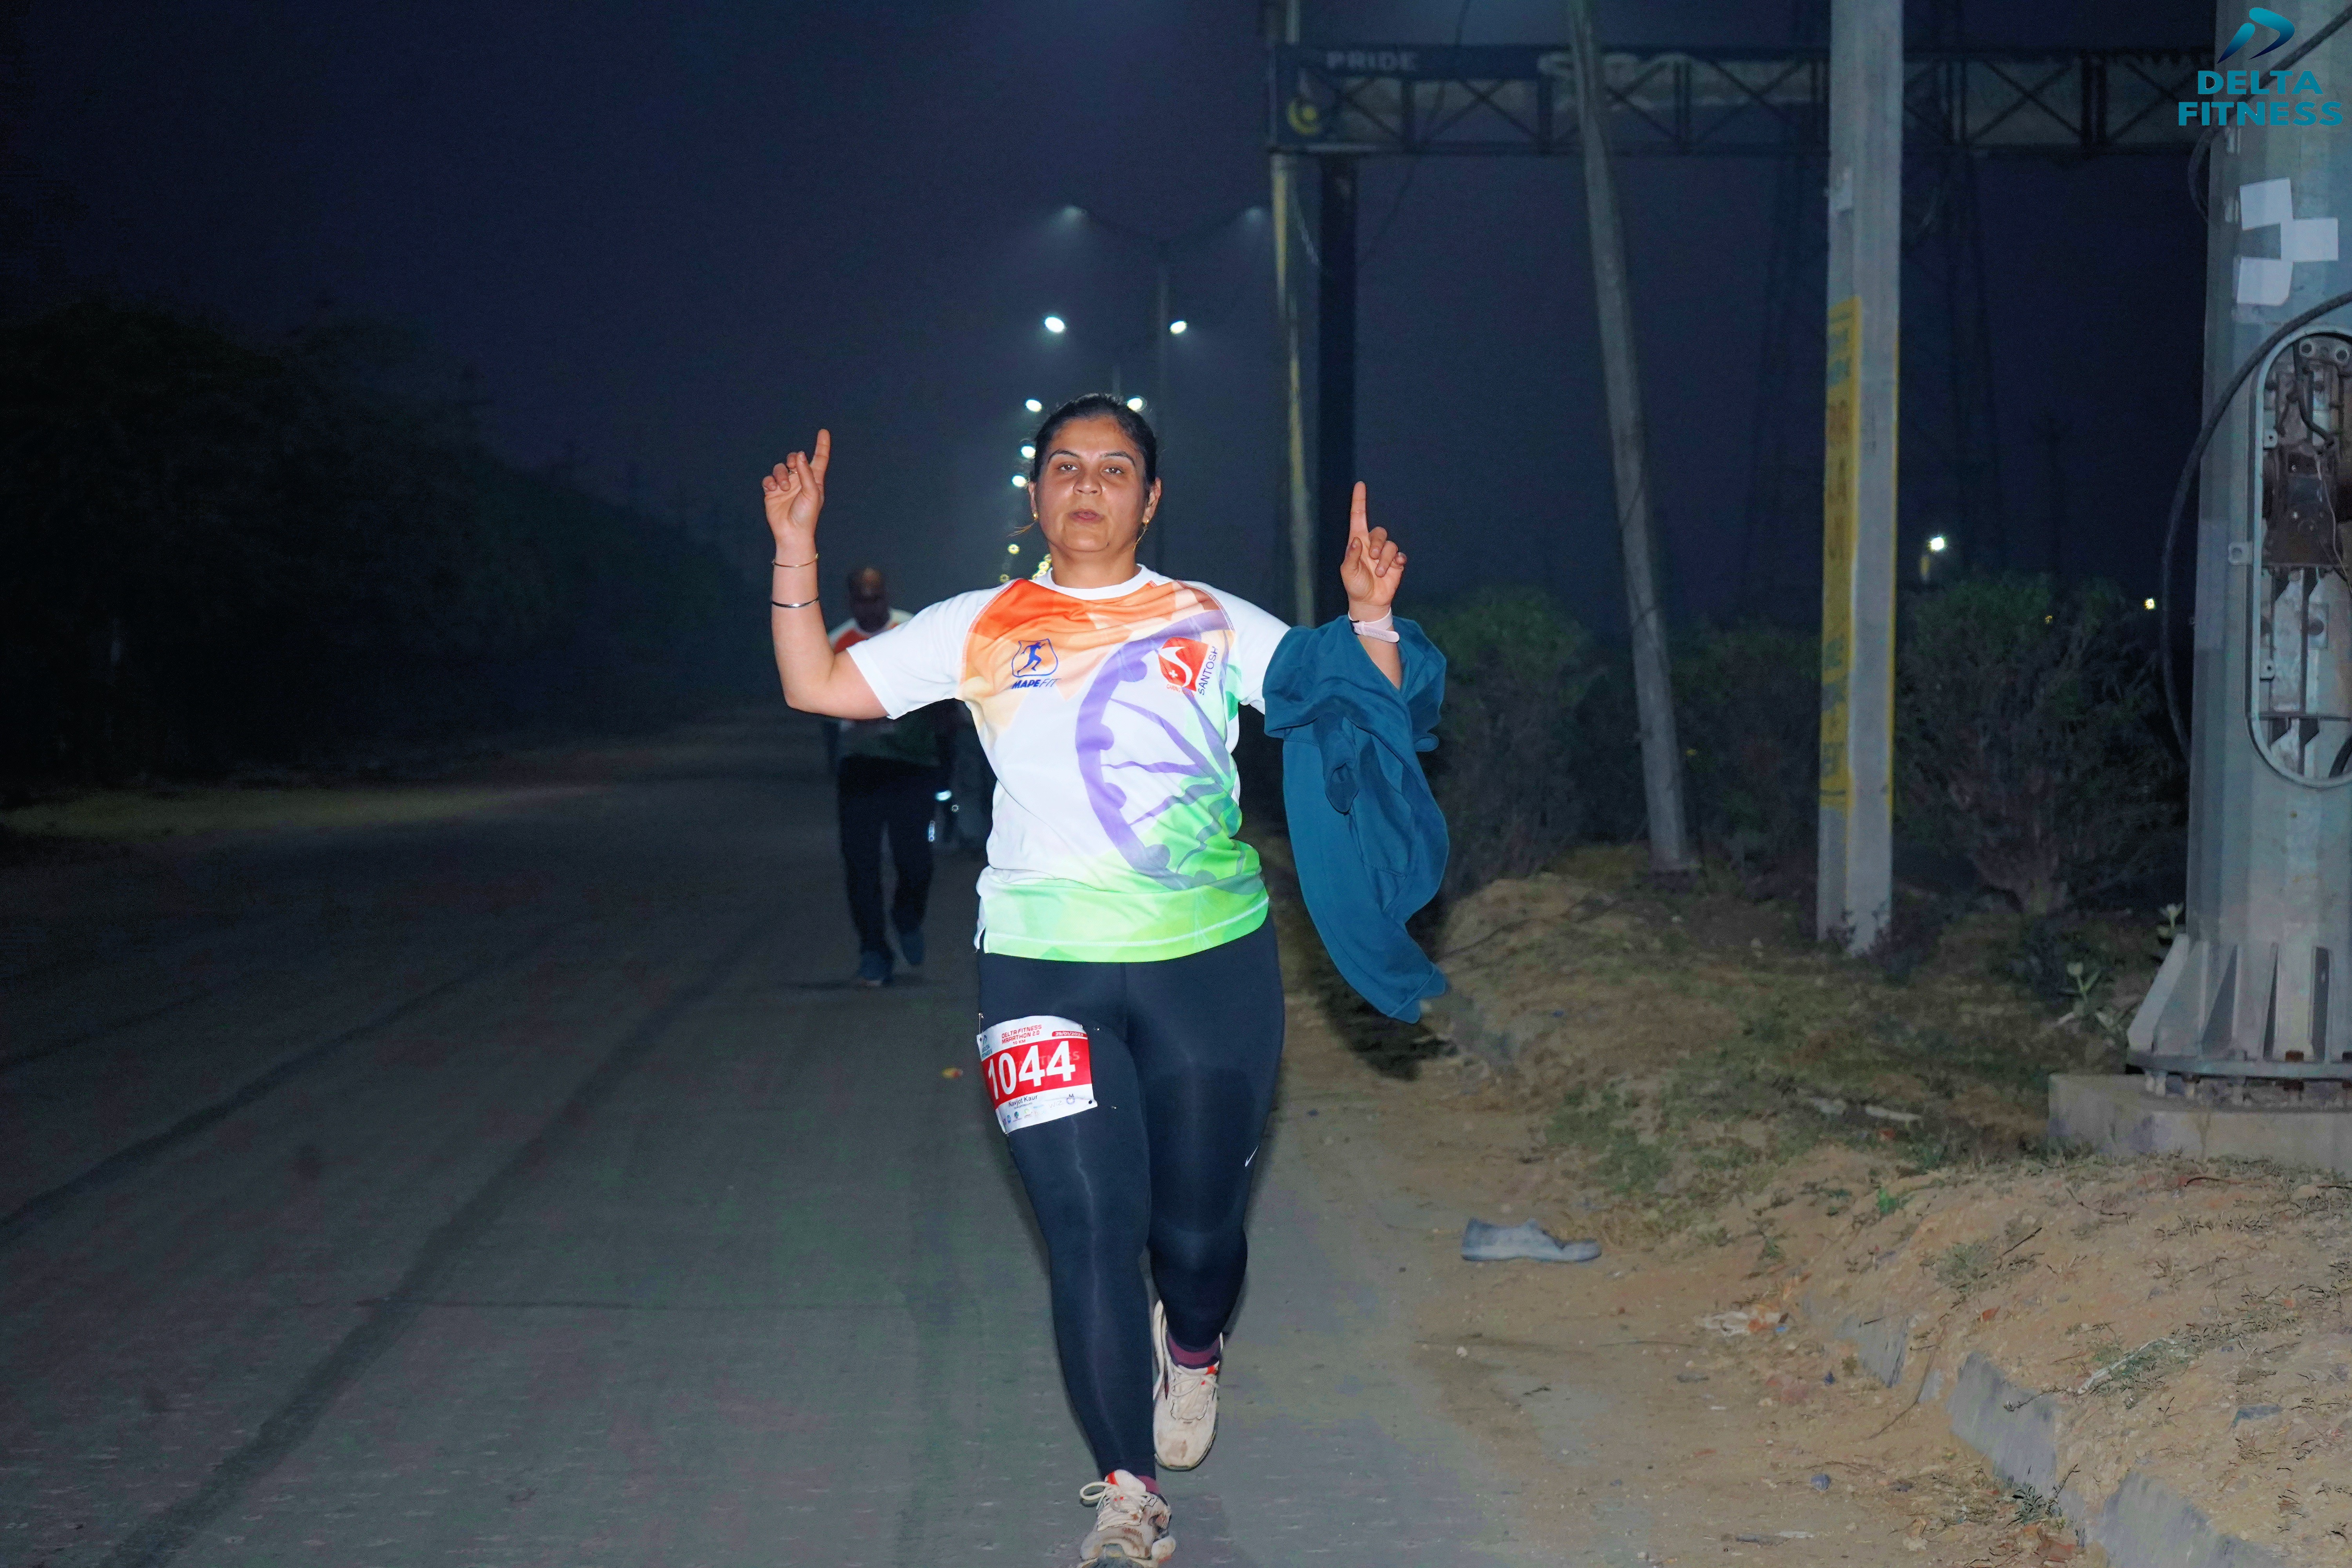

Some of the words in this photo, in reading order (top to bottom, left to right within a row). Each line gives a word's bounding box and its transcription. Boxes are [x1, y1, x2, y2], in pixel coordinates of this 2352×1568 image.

[1327, 51, 1418, 71] PRIDE
[1198, 646, 1218, 695] SANTOSH
[1002, 1030, 1017, 1038] DELTA
[1018, 1025, 1042, 1034] FITNESS
[1002, 1032, 1031, 1044] MARATHON
[988, 1040, 1076, 1100] 1044
[1008, 1098, 1023, 1107] Navjot
